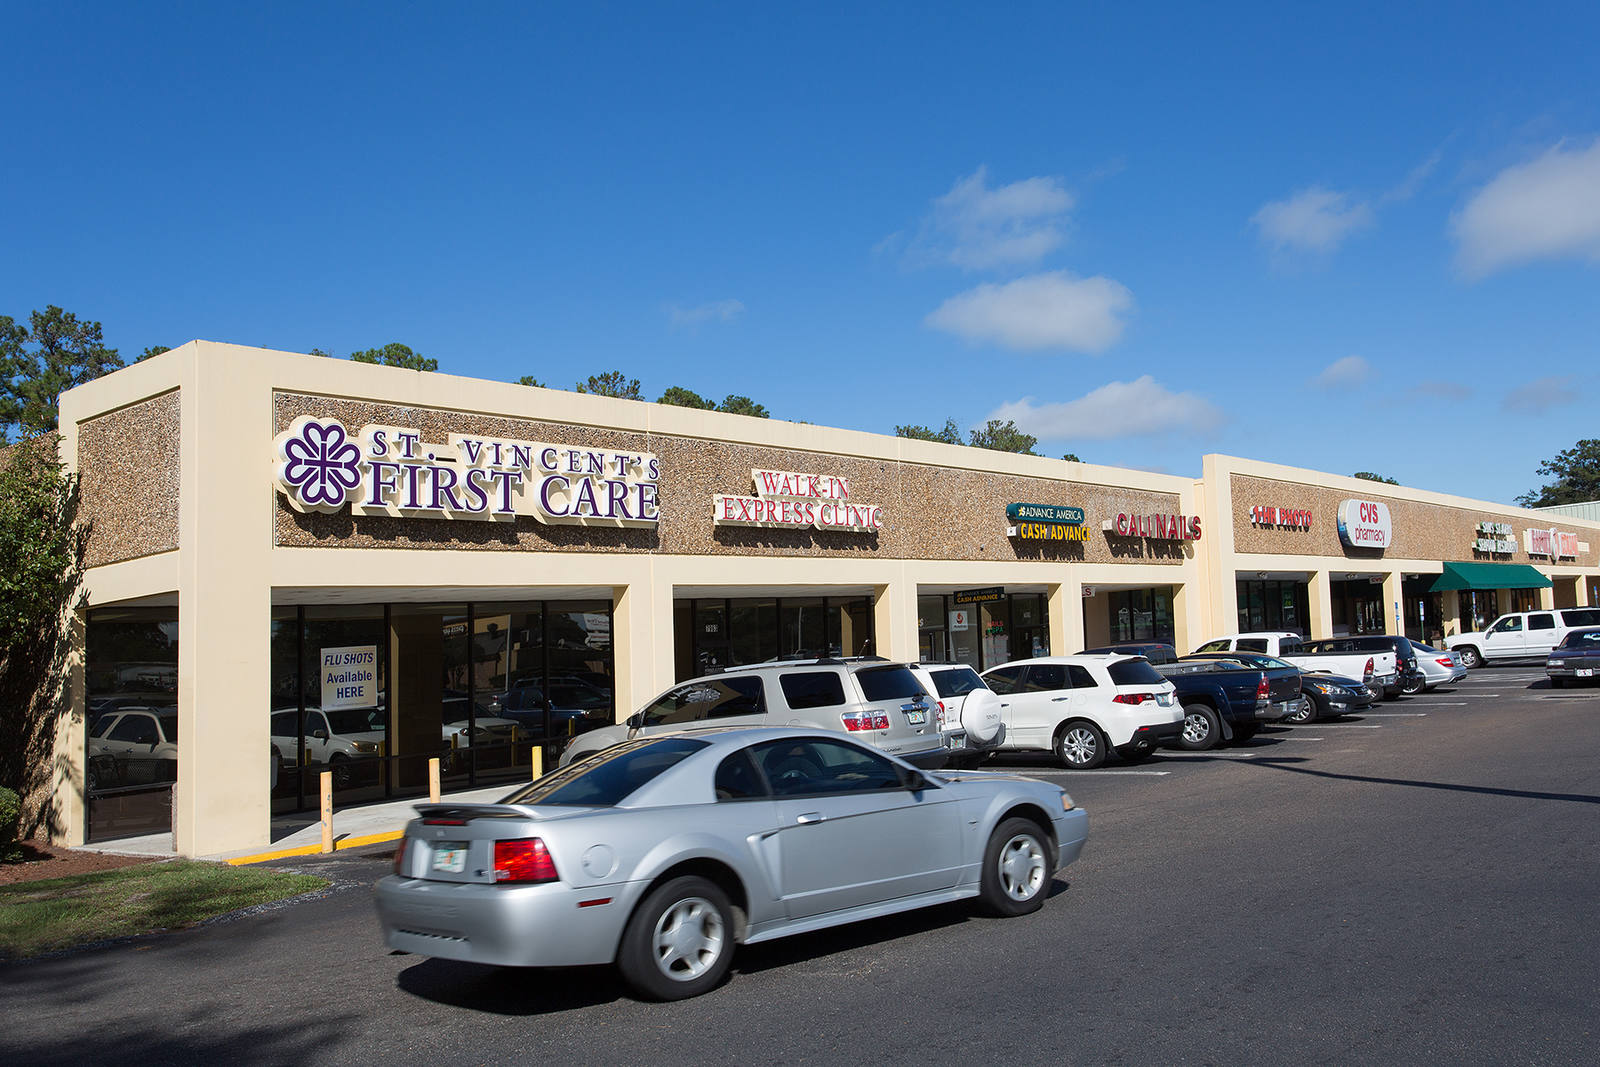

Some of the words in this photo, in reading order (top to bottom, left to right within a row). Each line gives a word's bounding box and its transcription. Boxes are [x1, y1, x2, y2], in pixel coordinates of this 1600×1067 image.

[463, 438, 660, 480] VINCENT'S
[366, 460, 523, 513] FIRST
[539, 474, 660, 521] CARE
[760, 471, 849, 500] WALK-IN
[722, 497, 815, 525] EXPRESS
[820, 503, 882, 529] CLINIC
[1025, 507, 1054, 520] ADVANCE
[1056, 508, 1082, 521] AMERICA
[1279, 507, 1313, 527] PHOTO
[1359, 502, 1379, 524] CVS
[1020, 523, 1047, 540] CASH
[1050, 525, 1091, 542] ADVANCE
[1117, 512, 1151, 537] CALI
[1155, 513, 1202, 541] NAILS
[1355, 524, 1385, 545] pharmacy
[324, 654, 342, 666] FLU
[343, 653, 374, 665] SHOTS
[327, 670, 373, 684] Available
[336, 686, 364, 699] HERE
